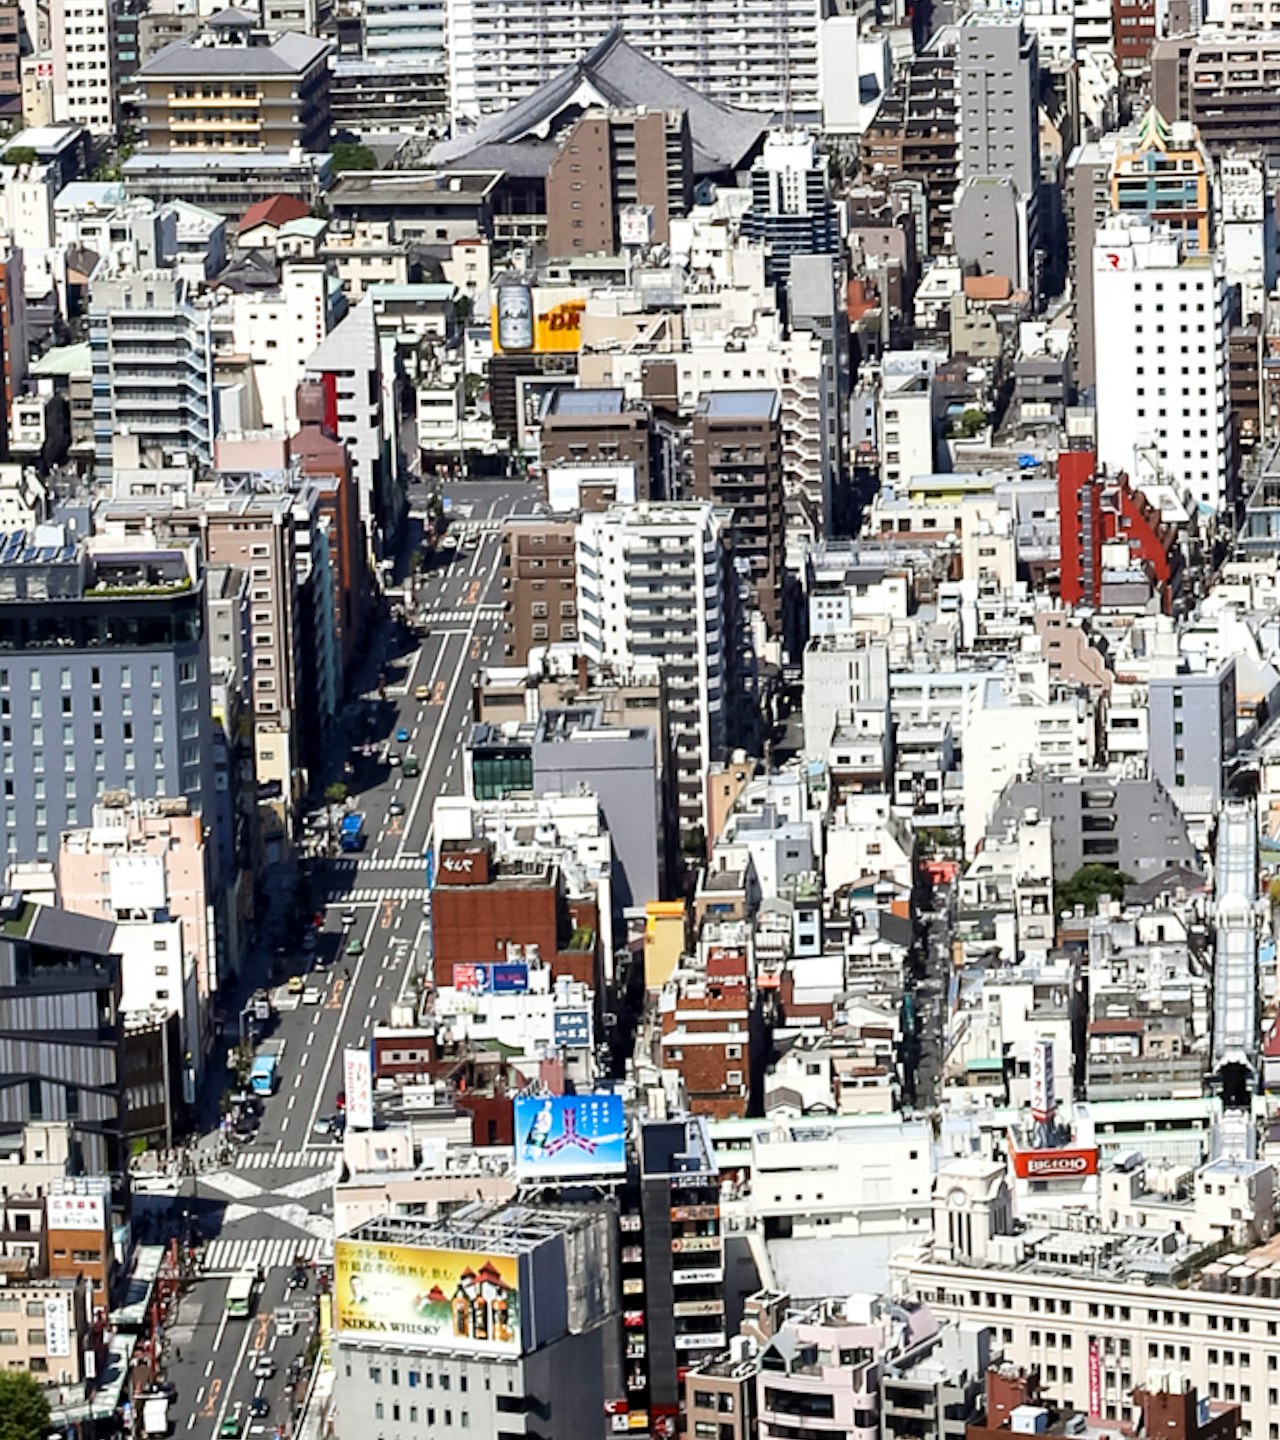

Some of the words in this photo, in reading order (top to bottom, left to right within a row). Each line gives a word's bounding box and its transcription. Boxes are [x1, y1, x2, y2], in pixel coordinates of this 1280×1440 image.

[549, 313, 580, 331] DR
[1033, 1046, 1043, 1107] カラオケ
[1028, 1159, 1050, 1173] BIG
[1051, 1157, 1087, 1171] ECHO
[341, 1317, 387, 1332] NIKKA
[390, 1322, 441, 1336] WHISKY
